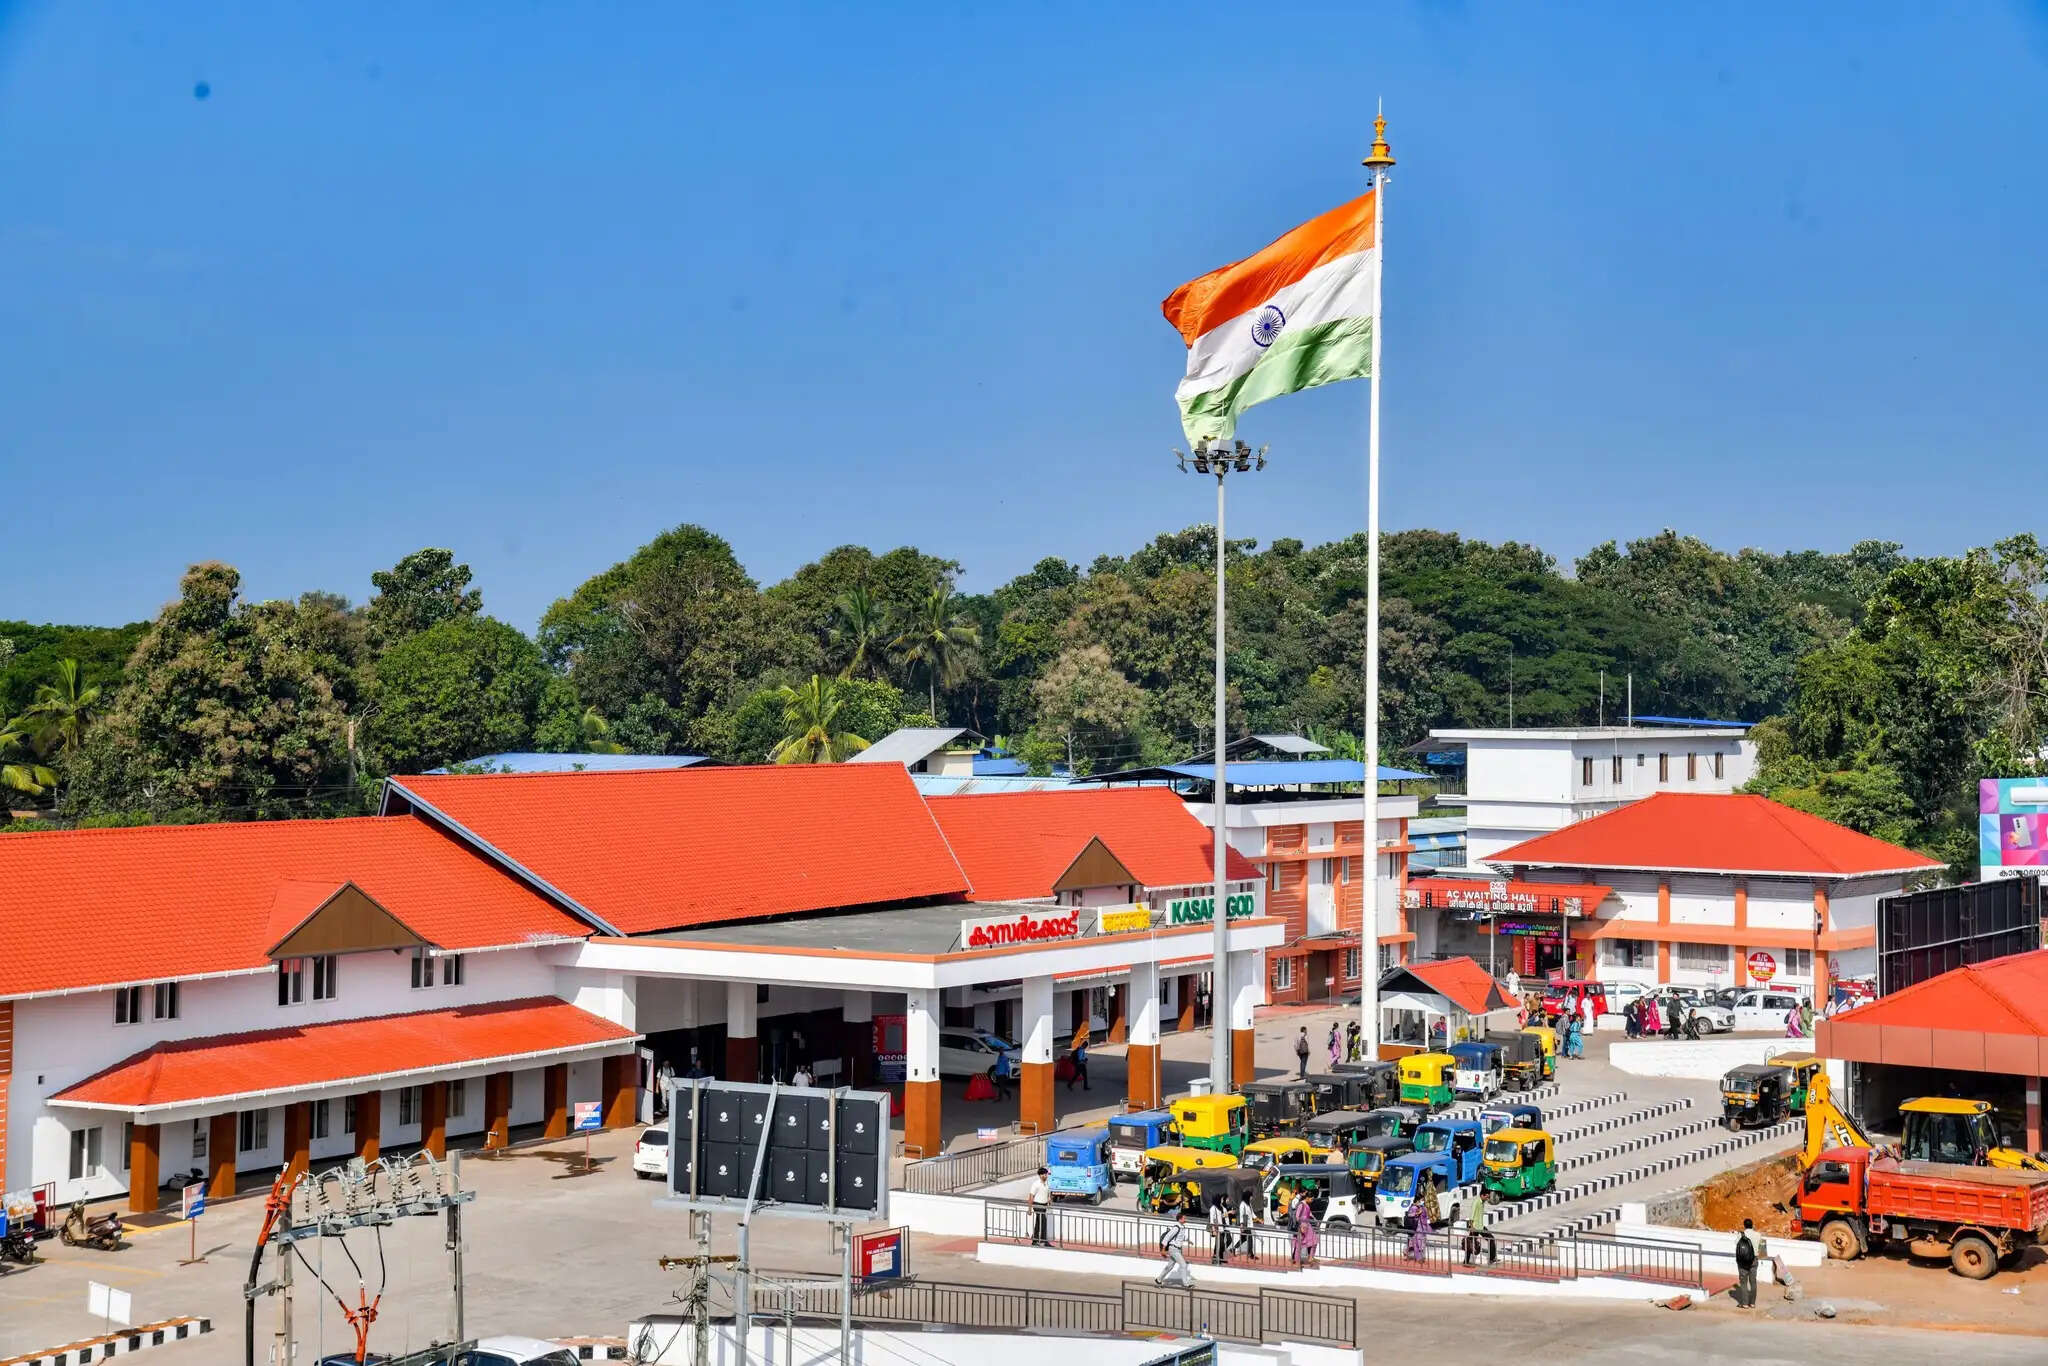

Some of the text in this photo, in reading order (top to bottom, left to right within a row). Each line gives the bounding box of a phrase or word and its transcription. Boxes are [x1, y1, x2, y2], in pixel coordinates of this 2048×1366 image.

[1446, 889, 1538, 903] AC WAITING HALL
